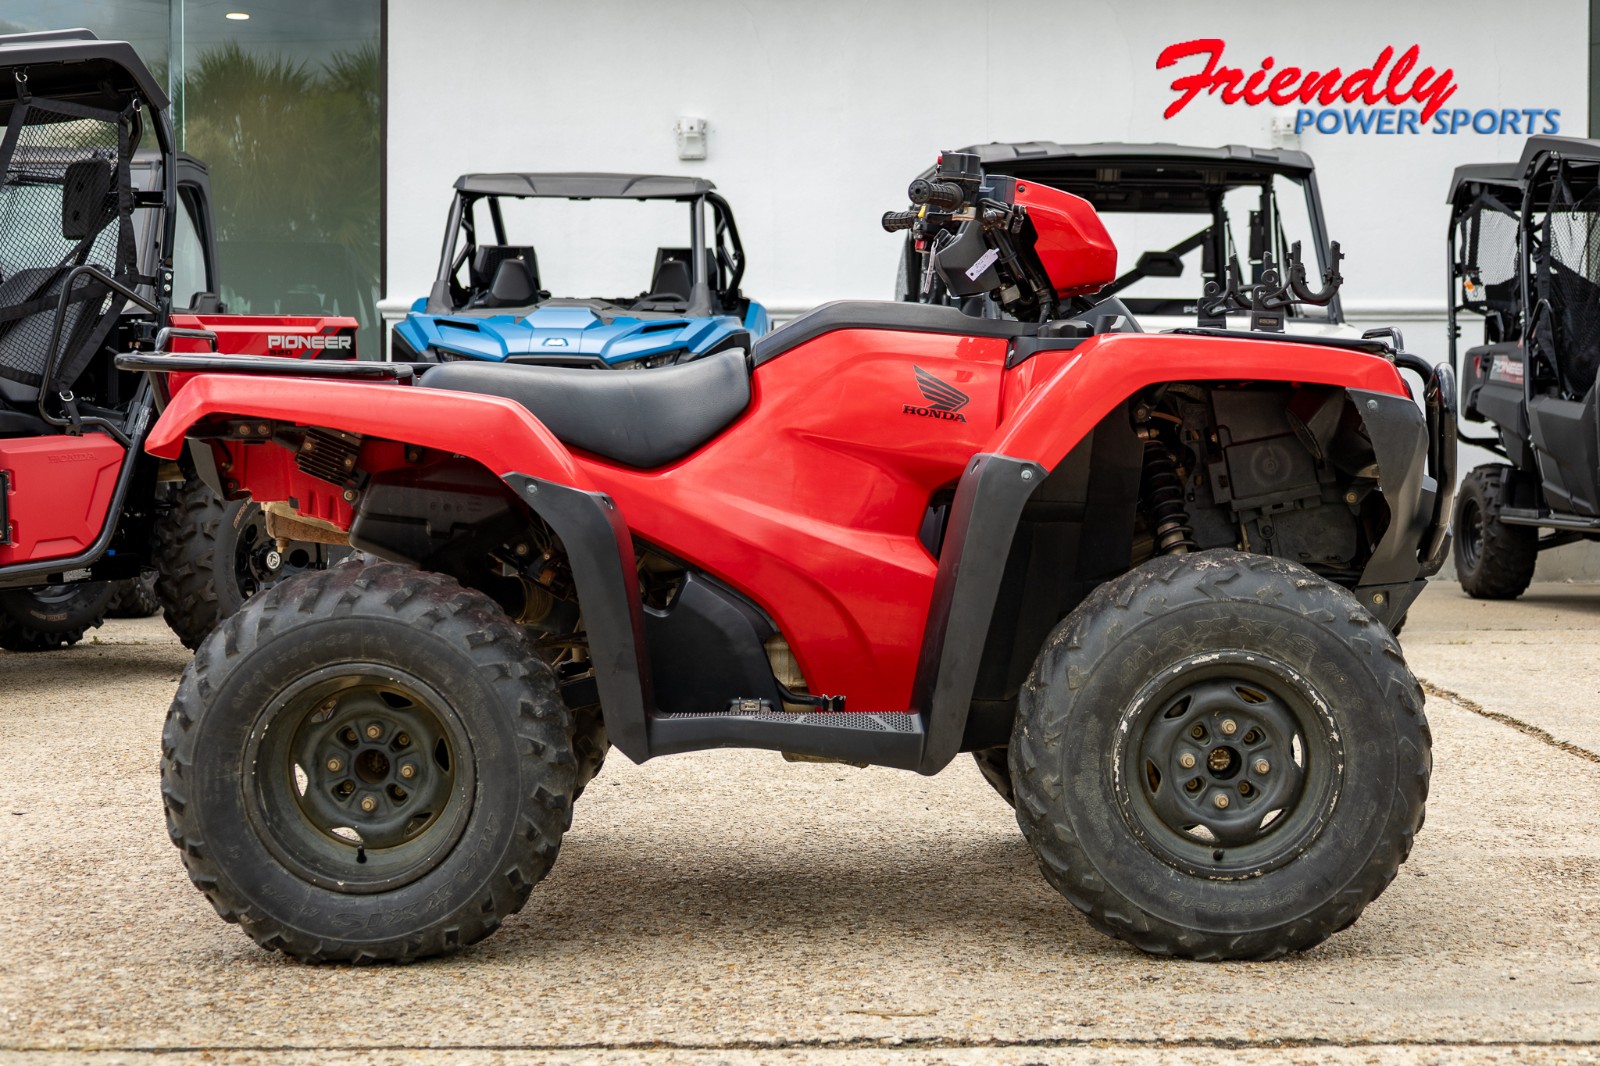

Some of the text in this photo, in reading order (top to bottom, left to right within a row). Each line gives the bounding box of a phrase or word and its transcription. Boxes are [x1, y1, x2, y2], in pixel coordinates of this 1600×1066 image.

[267, 335, 352, 350] PIONEER
[902, 404, 967, 423] HONDA
[1120, 617, 1318, 684] MAXXIS
[333, 811, 499, 930] MAXXIS
